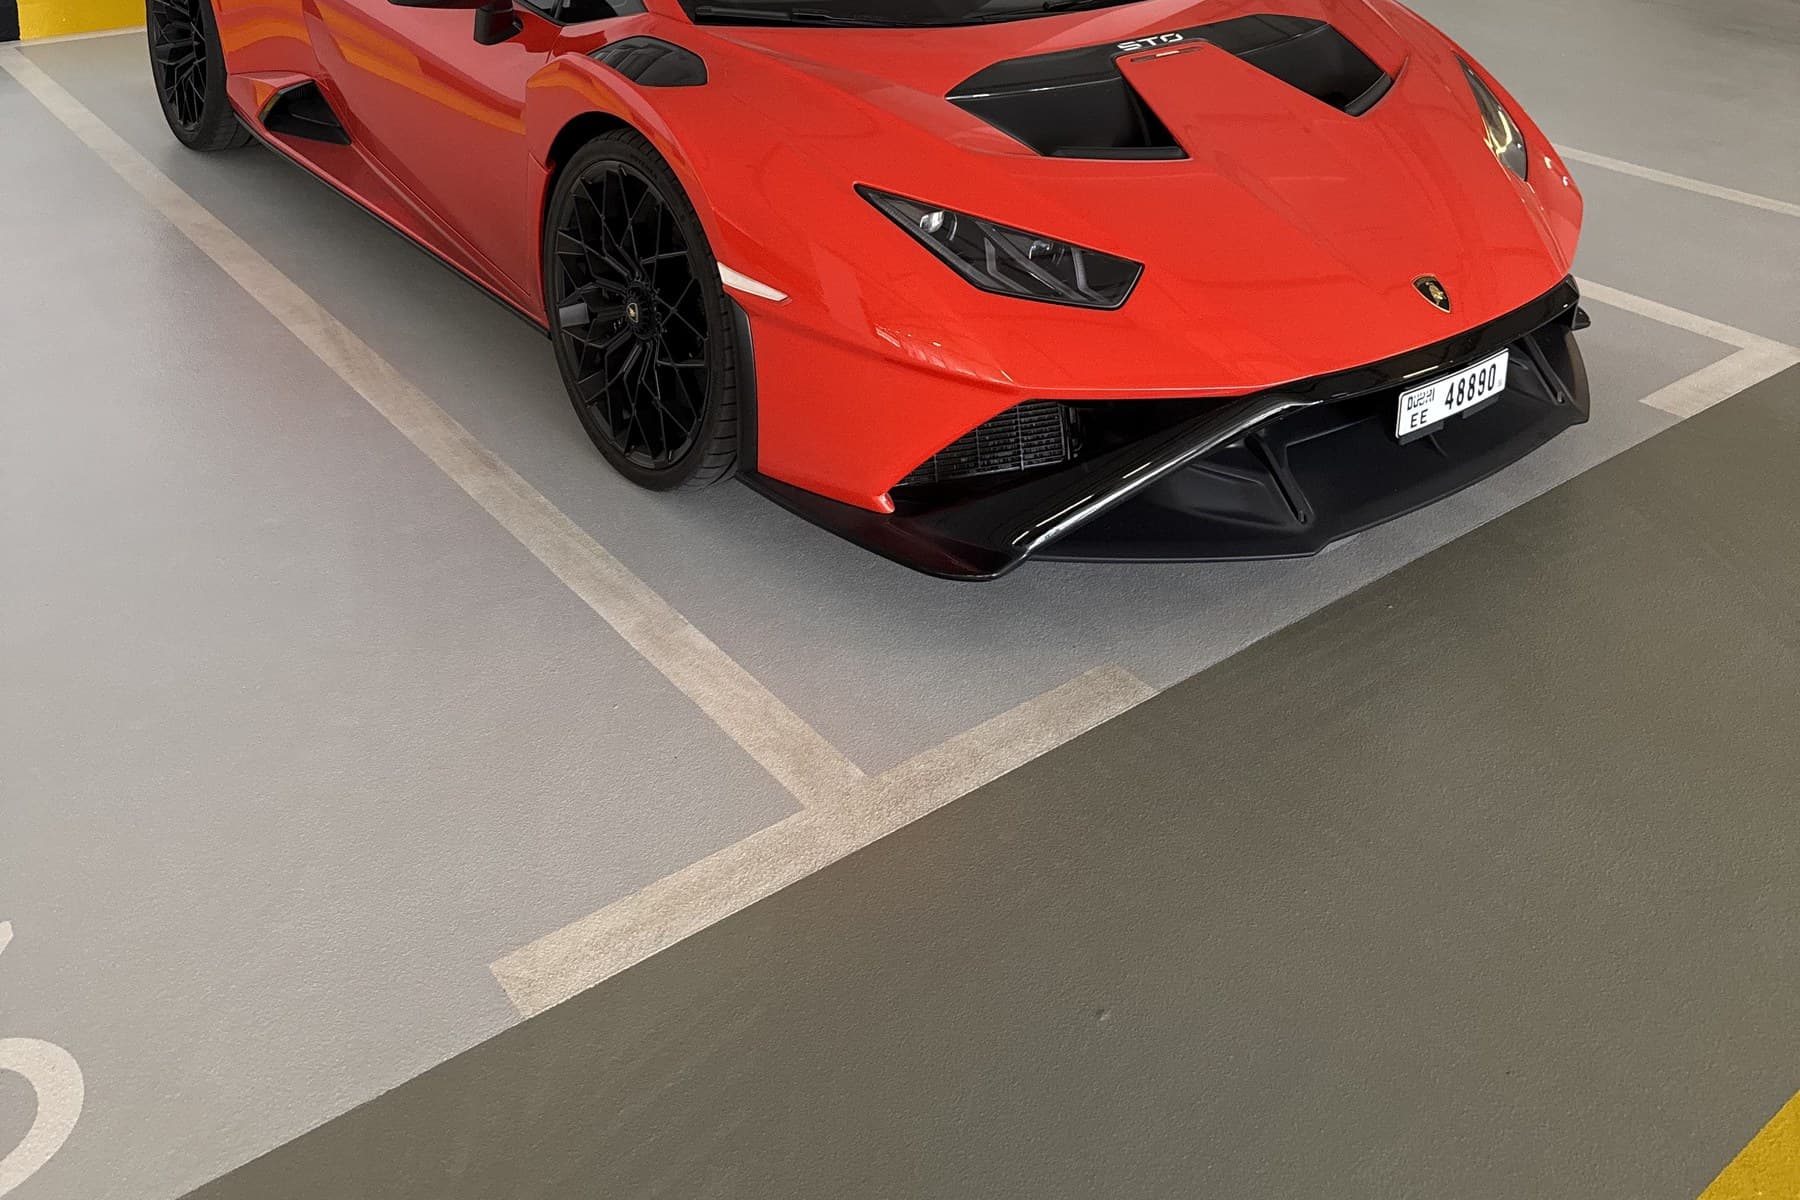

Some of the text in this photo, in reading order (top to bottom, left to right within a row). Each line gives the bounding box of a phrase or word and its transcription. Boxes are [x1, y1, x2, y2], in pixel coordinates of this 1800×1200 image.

[1117, 33, 1184, 52] STO
[1444, 363, 1497, 411] 48890
[1410, 408, 1429, 429] EE
